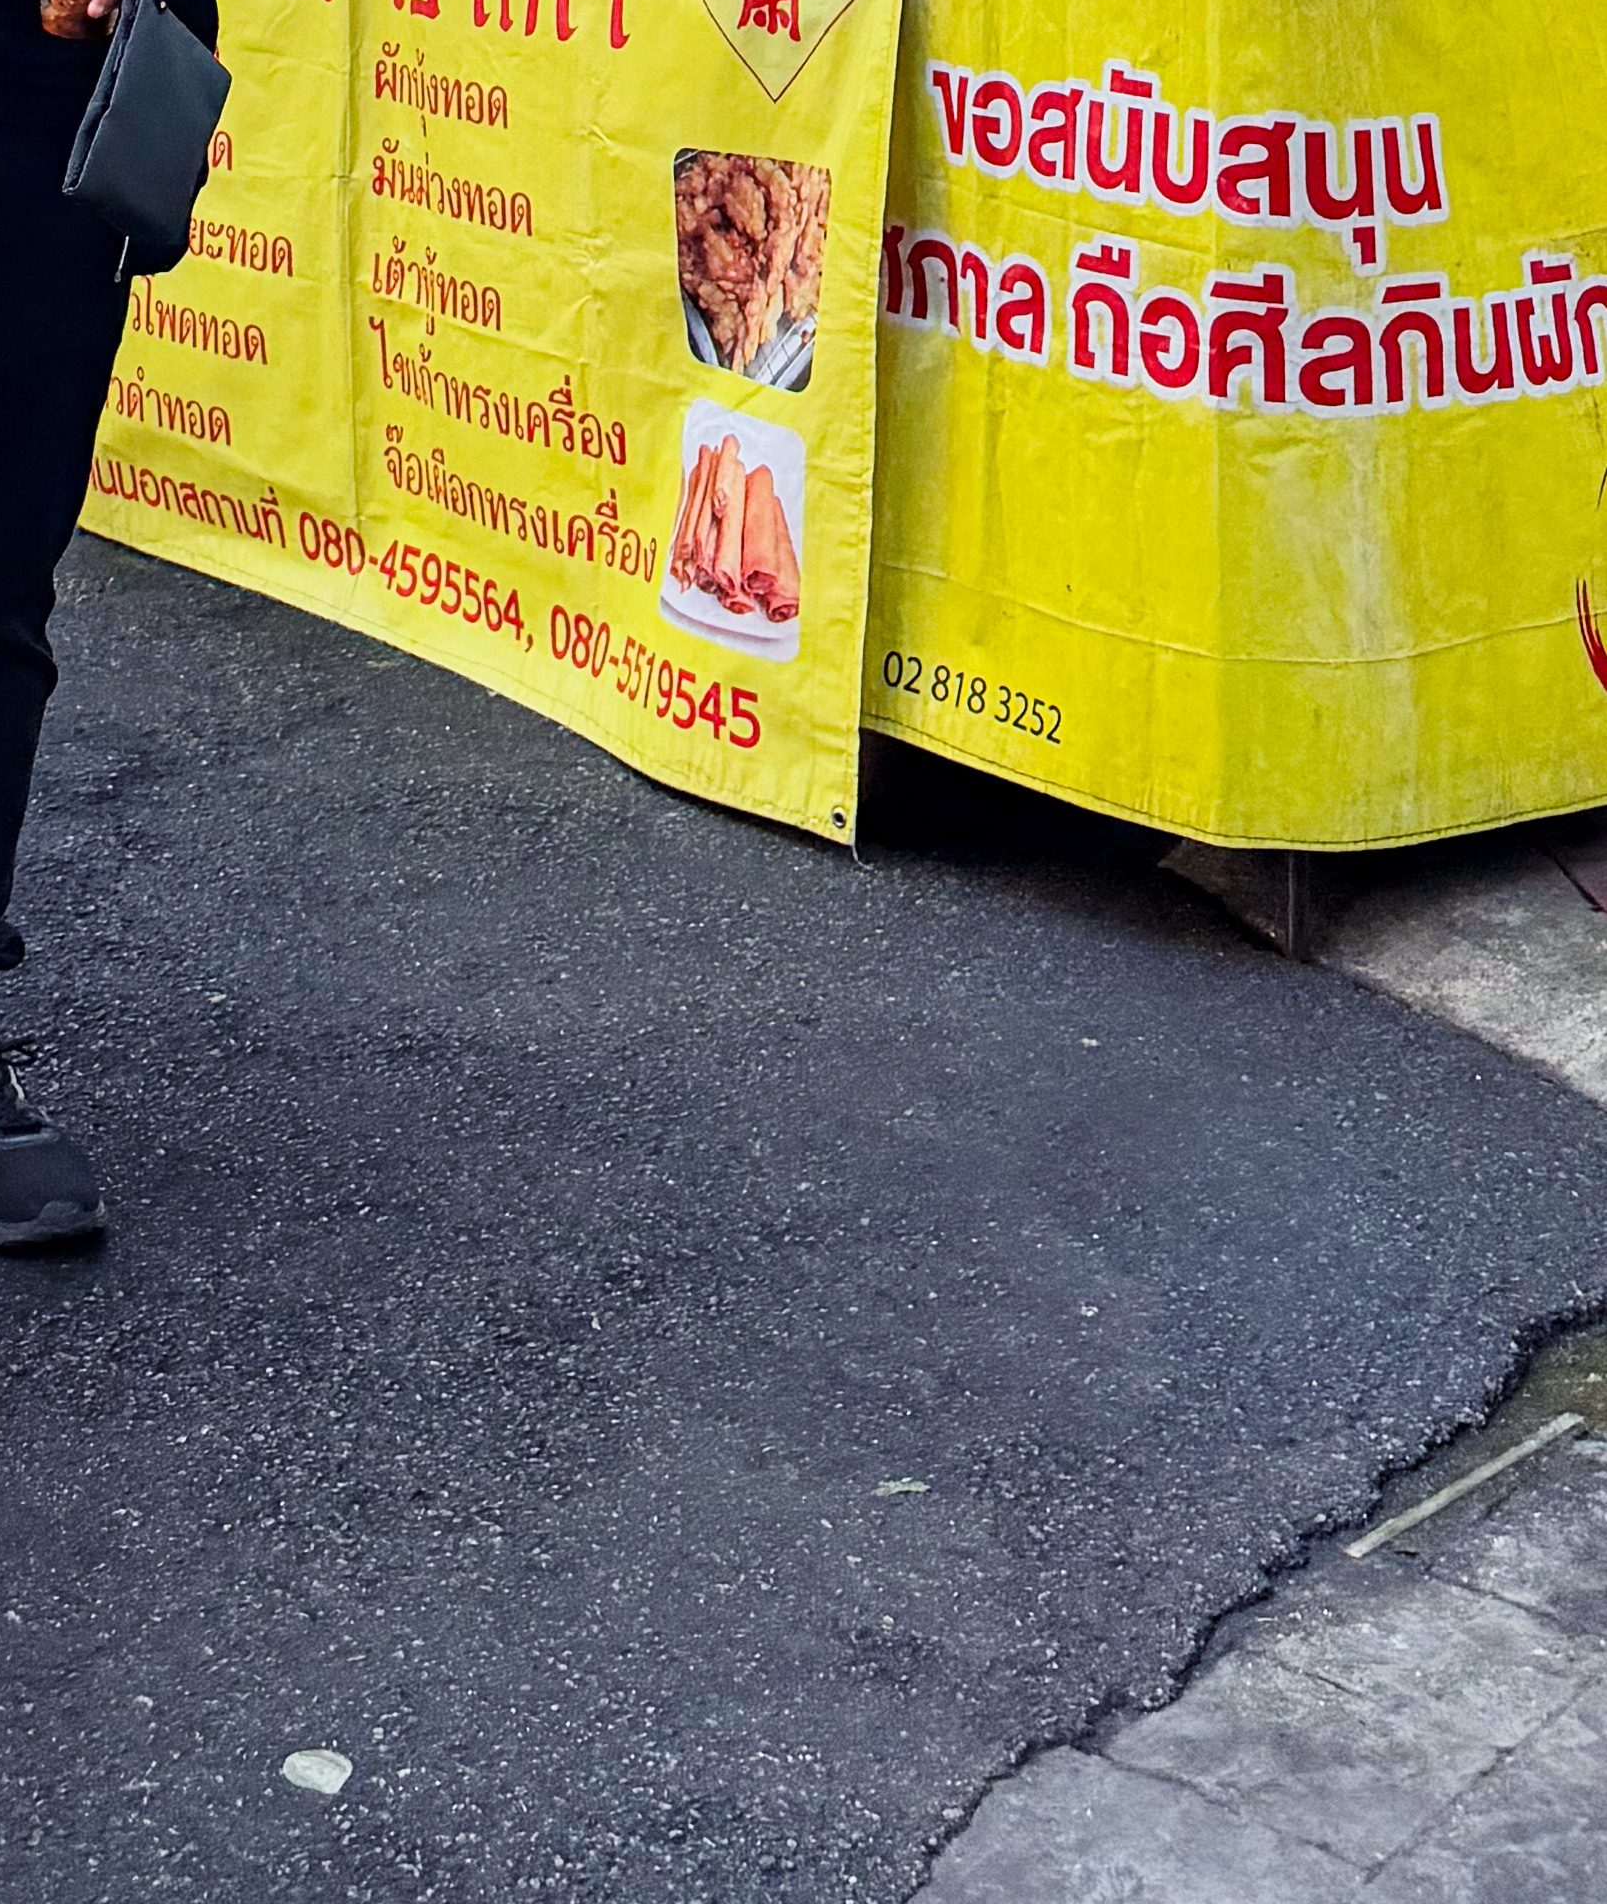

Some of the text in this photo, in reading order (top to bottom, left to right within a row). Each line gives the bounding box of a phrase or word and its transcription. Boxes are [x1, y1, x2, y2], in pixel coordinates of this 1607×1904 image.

[374, 42, 509, 136] ผักบุ้งทอด
[372, 138, 533, 238] มันม่วงทอด
[932, 68, 1443, 267] ขอสนับสนุน
[188, 216, 294, 278] ยะทอด
[373, 245, 502, 335] เต้าหู้ทอด
[130, 275, 268, 365] วโพดทอด
[105, 365, 232, 447] วดำทอด
[549, 604, 763, 751] 080-5519545
[882, 649, 1064, 746] 02 818 3252
